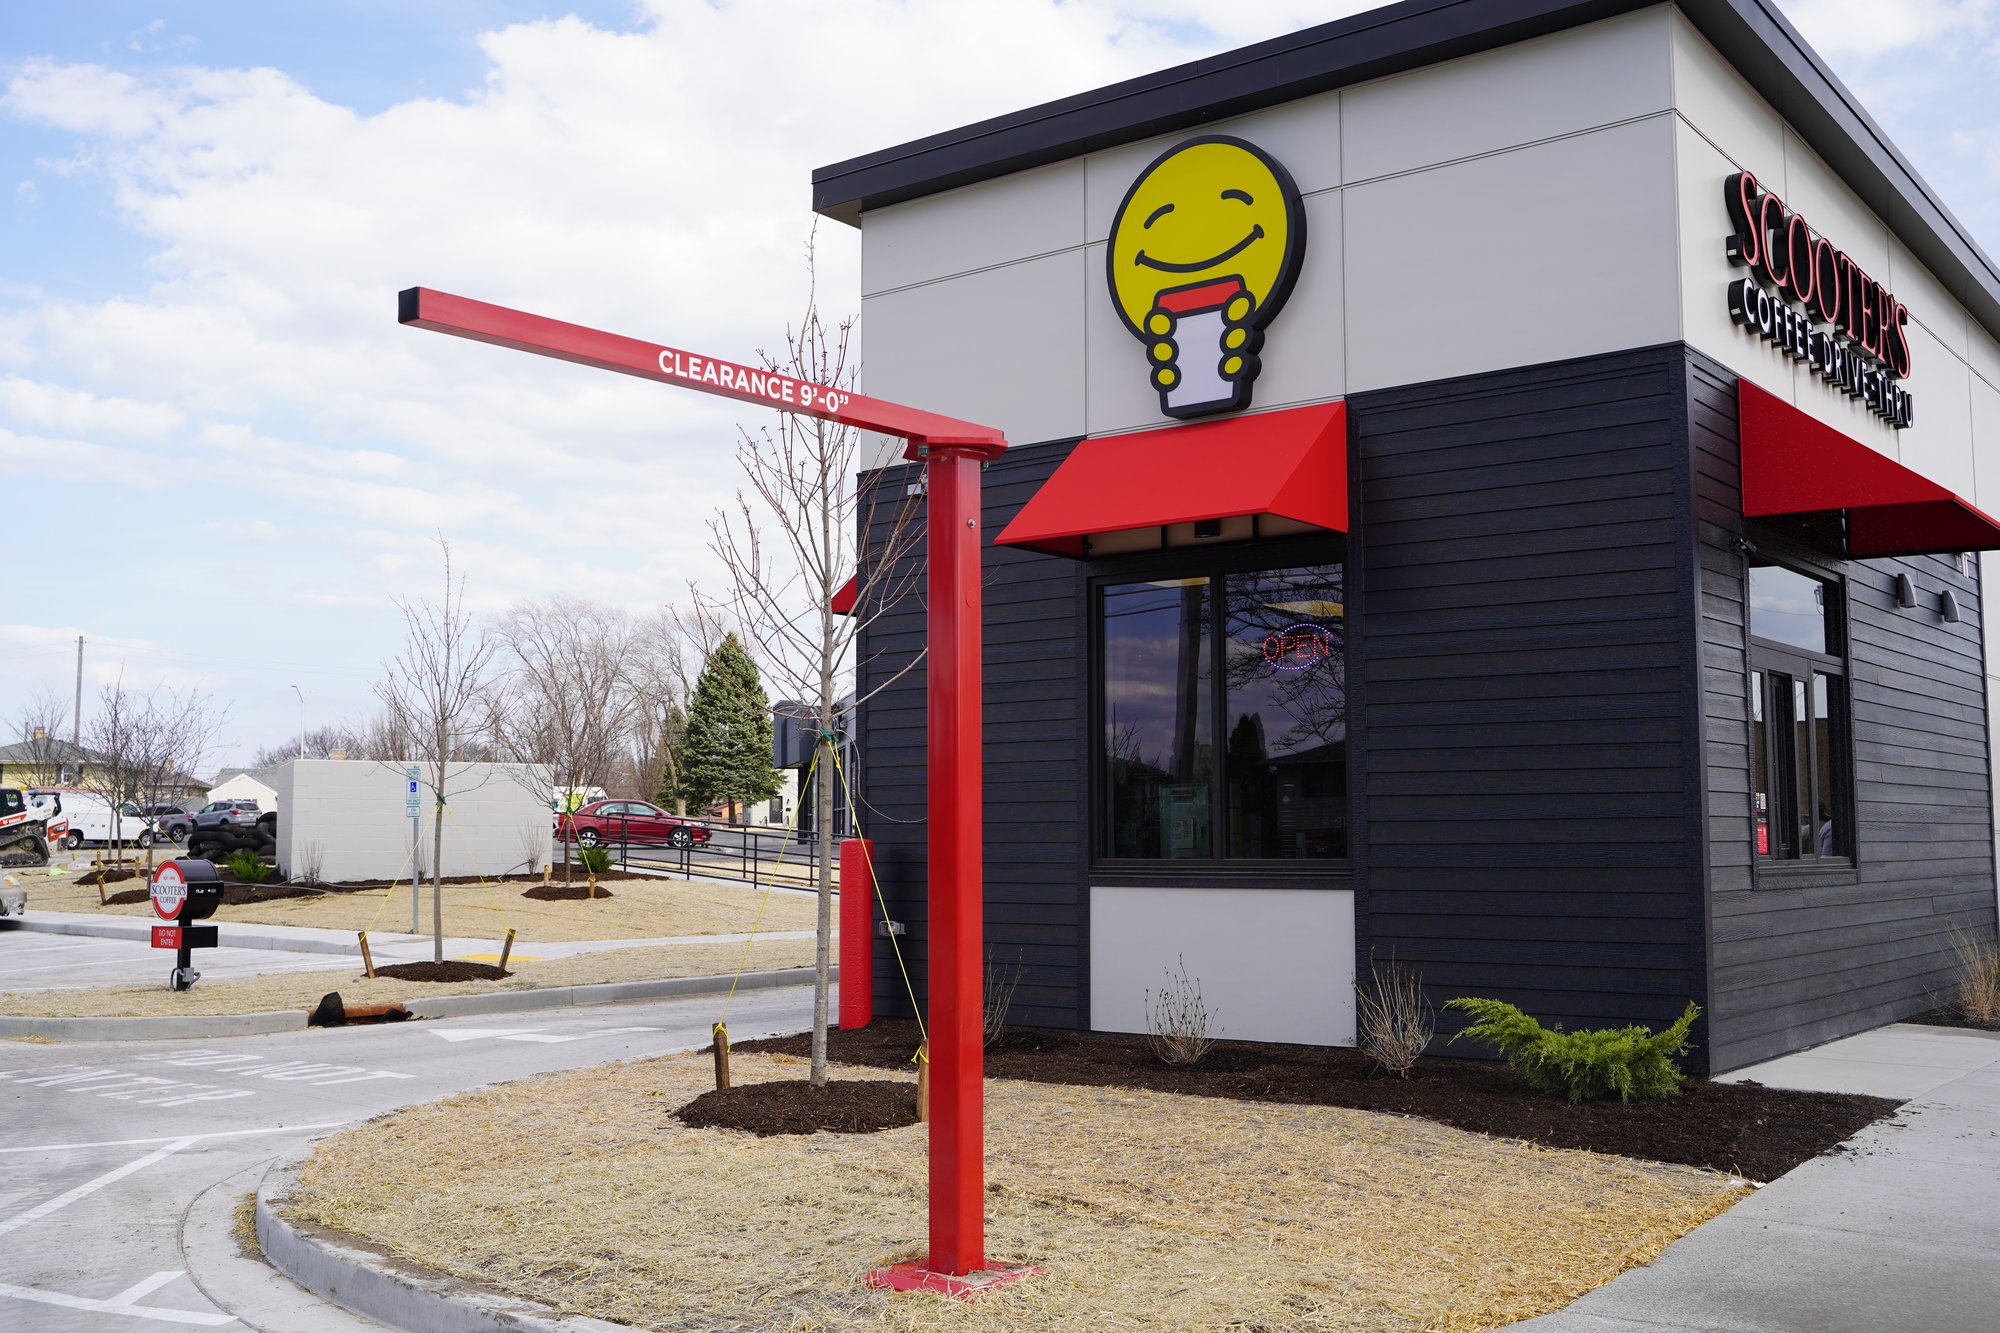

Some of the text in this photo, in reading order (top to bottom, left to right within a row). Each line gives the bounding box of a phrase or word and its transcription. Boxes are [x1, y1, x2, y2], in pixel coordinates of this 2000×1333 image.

[1725, 171, 1910, 379] SCOOTER'S
[1728, 278, 1814, 362] COFFEE
[658, 350, 795, 403] CLEARANCE
[1263, 632, 1329, 659] OPEN
[151, 884, 186, 896] SCOOTER'S
[159, 896, 177, 904] COFFEE
[158, 929, 176, 937] DO NOT
[160, 937, 173, 946] ENTER
[213, 1060, 417, 1086] NOT
